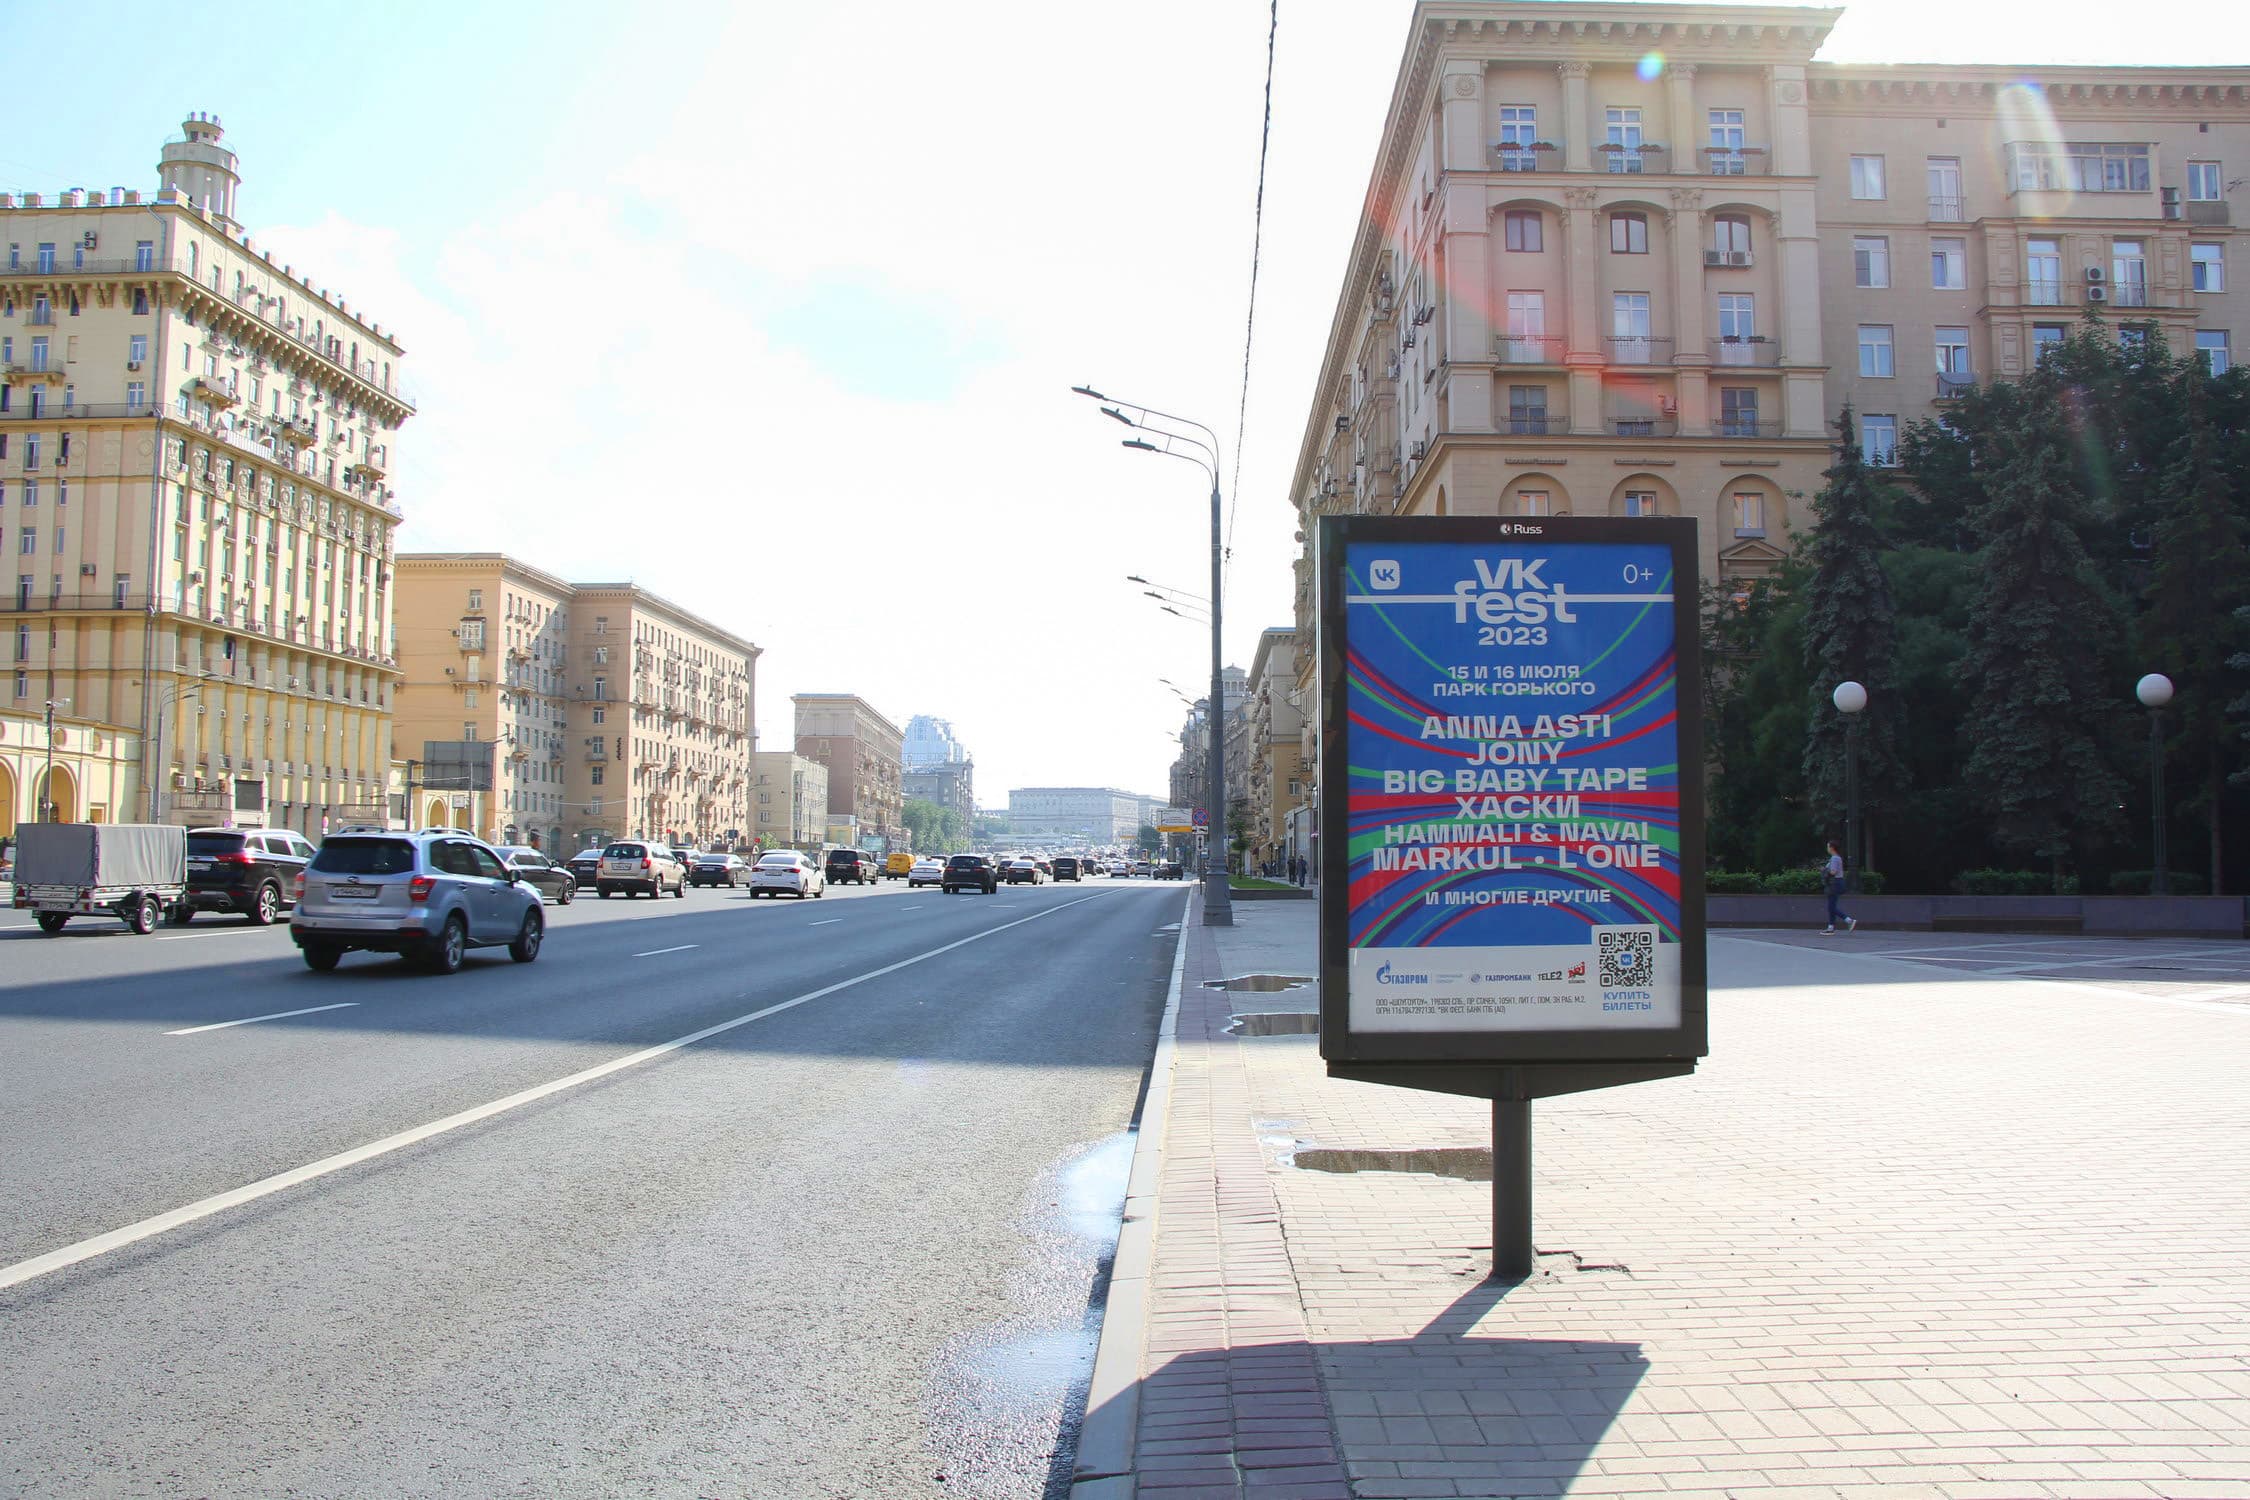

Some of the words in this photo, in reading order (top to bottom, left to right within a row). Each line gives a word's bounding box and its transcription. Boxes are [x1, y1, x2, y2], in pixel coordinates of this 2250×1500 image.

[1514, 524, 1542, 534] Russ
[1474, 558, 1549, 590] VK
[1622, 564, 1654, 584] 0+
[1454, 580, 1577, 624] fest
[1478, 626, 1548, 646] 2023
[1448, 666, 1469, 680] 15
[1474, 666, 1489, 680] И
[1494, 666, 1515, 680] 16
[1520, 665, 1580, 679] ИЮЛЯ
[1433, 683, 1489, 698] ПАРК
[1492, 682, 1596, 696] ГОРЬКОГО
[1420, 714, 1524, 740] ANNA
[1532, 714, 1611, 739] ASTI
[1466, 741, 1566, 766] JONY
[1384, 769, 1445, 794] BIG
[1455, 768, 1550, 793] BABY
[1557, 767, 1648, 792] TAPE
[1454, 795, 1580, 820] ХАСКИ
[1384, 823, 1521, 844] HAMMALI
[1530, 823, 1552, 844] &
[1560, 822, 1648, 842] NAVAI
[1372, 845, 1522, 872] MARKUL
[1558, 844, 1660, 868] L'ONE
[1425, 891, 1440, 906] И
[1444, 890, 1528, 906] МНОГИЕ
[1532, 889, 1611, 906] ДРУГИЕ
[1391, 974, 1428, 985] ГАЗПРОМ
[1484, 974, 1532, 983] ГАЗПРОМБАНК
[1536, 970, 1563, 982] TELE2
[1603, 991, 1651, 1001] КУПИТЬ
[1602, 1002, 1652, 1011] БИЛЕТЫ
